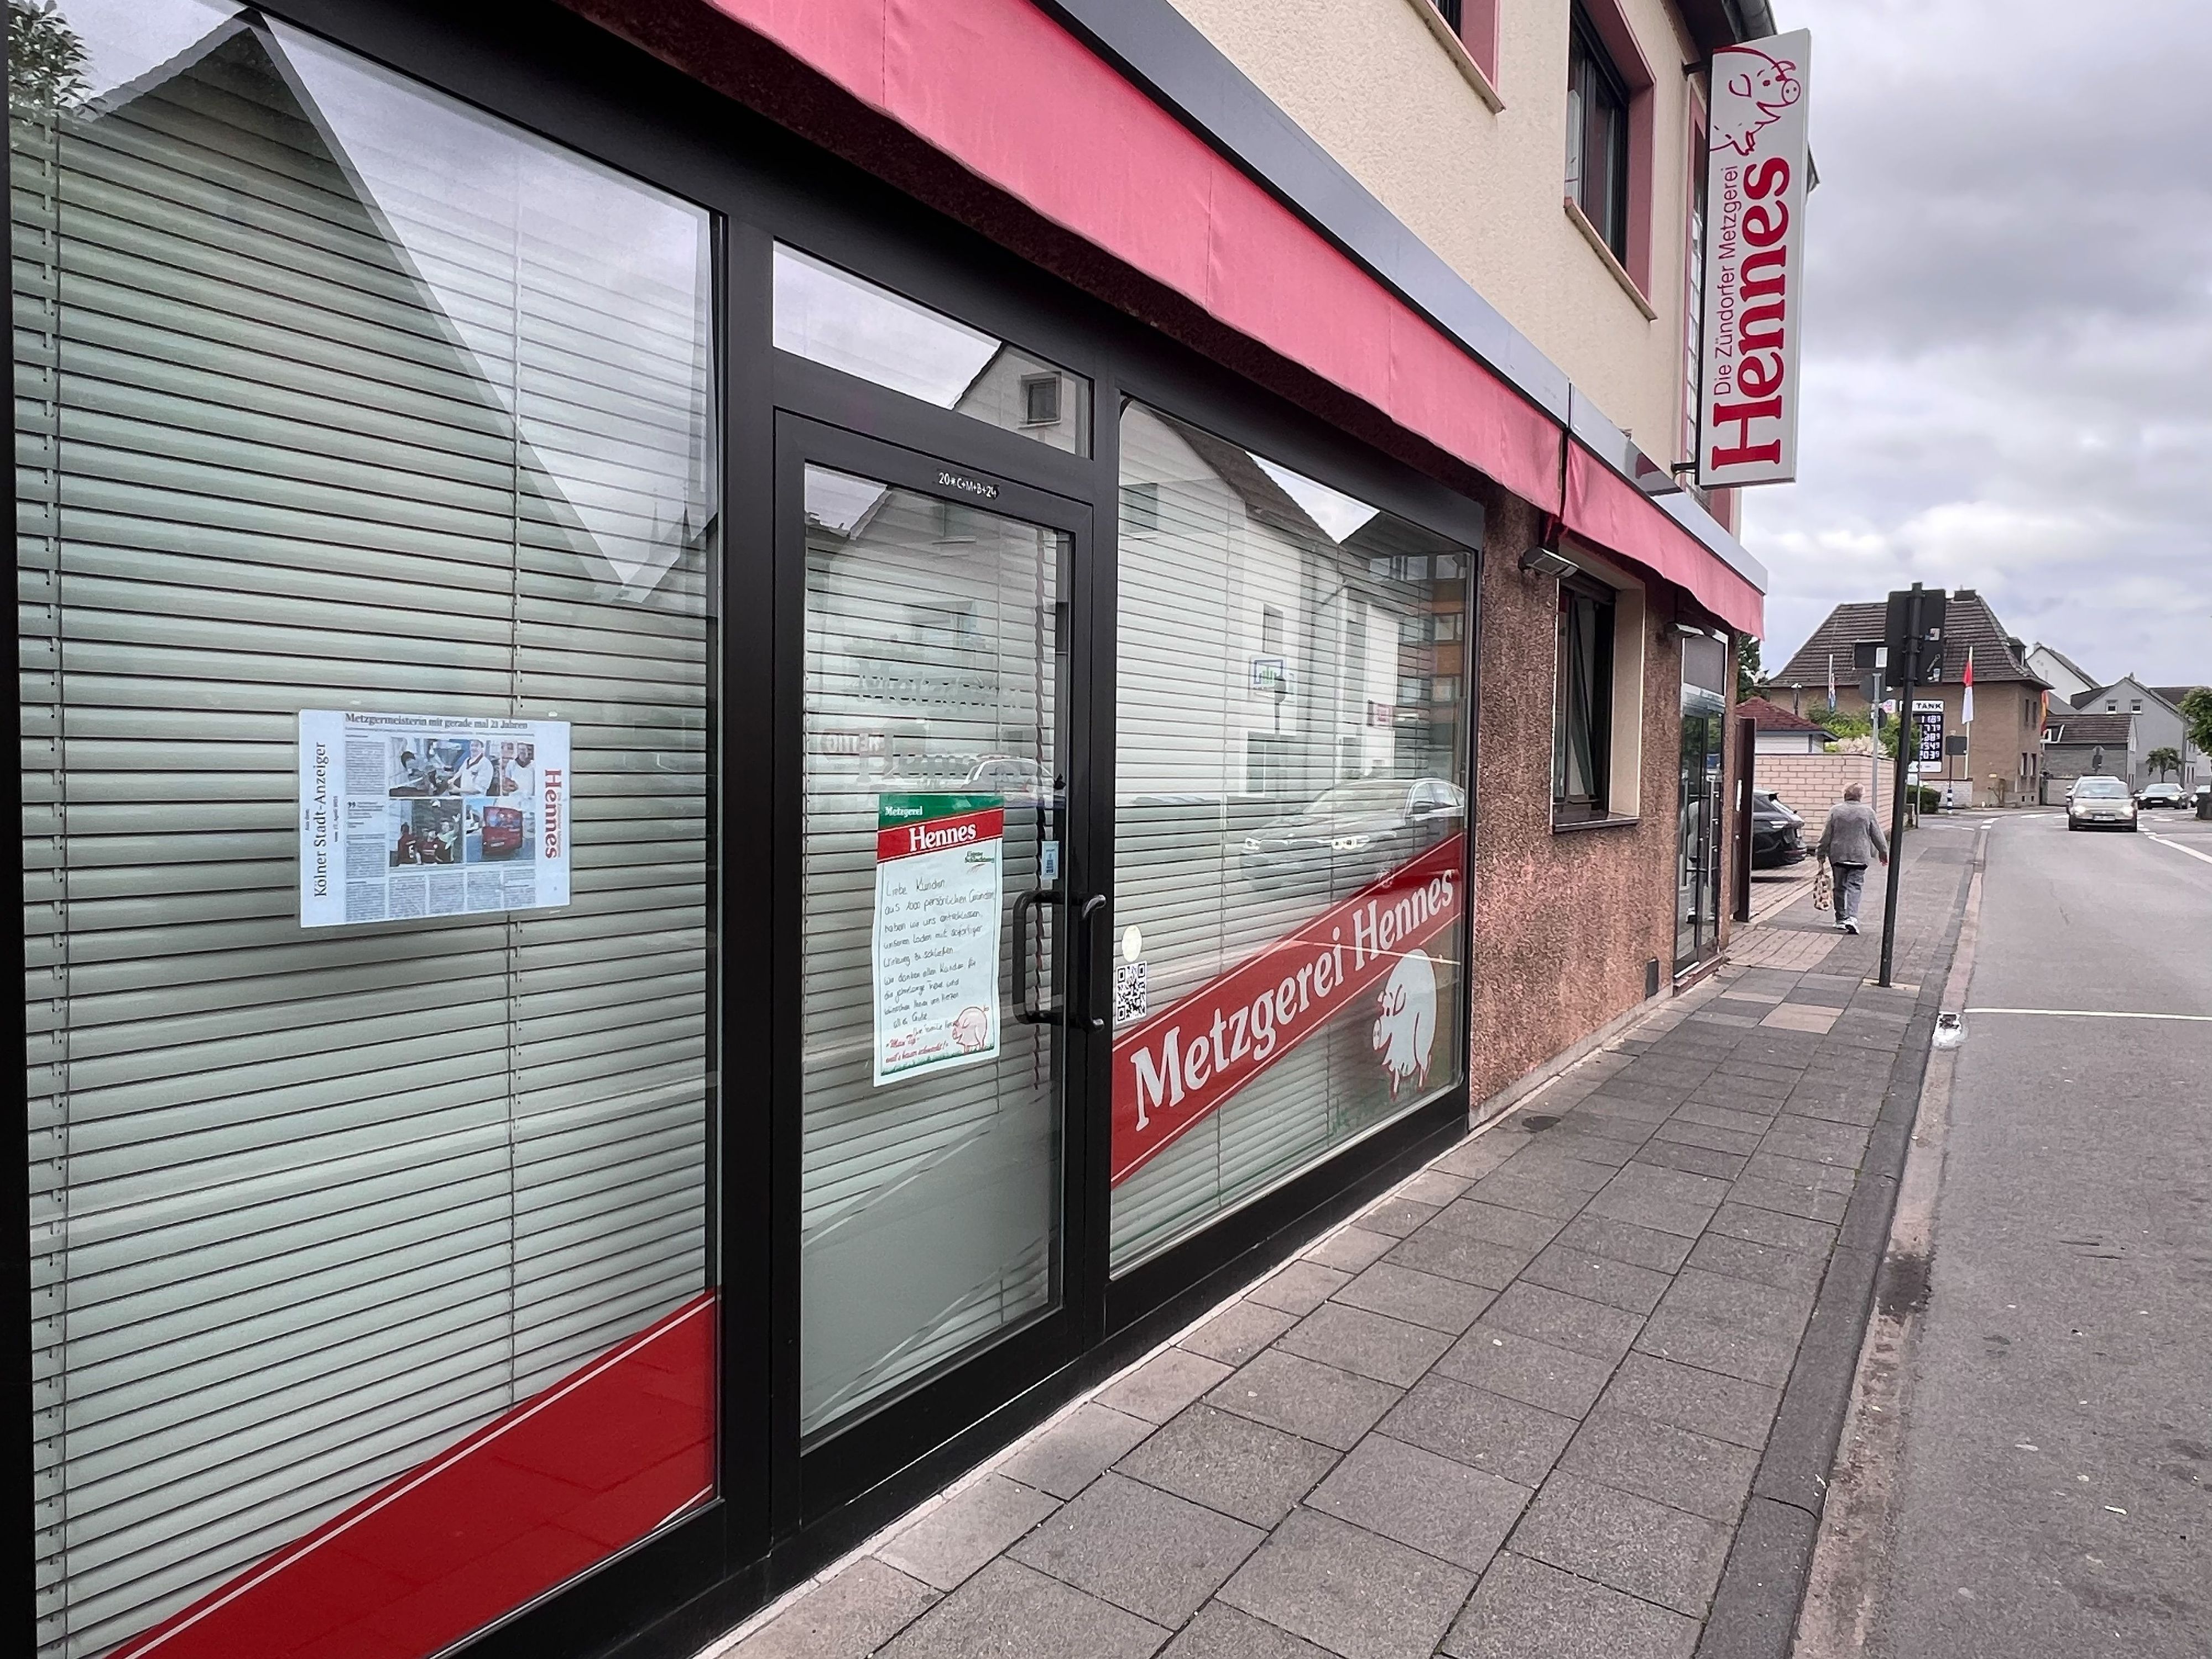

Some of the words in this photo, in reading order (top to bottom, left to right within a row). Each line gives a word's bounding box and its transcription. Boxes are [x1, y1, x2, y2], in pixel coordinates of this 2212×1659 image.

[1718, 165, 1742, 260] Metzgerei
[1712, 157, 1790, 471] Hennes
[1715, 267, 1735, 358] Zündorfer
[1714, 364, 1732, 395] Die
[345, 713, 427, 726] Metzgermeisterin
[445, 718, 472, 729] gerade
[474, 719, 488, 728] mal
[491, 720, 498, 728] 21
[500, 720, 528, 729] Jahren
[313, 742, 329, 847] Stadt-Anzeiger
[545, 769, 562, 858] Hennes
[885, 806, 923, 818] Metzgerei
[909, 823, 977, 852] Hennes
[314, 851, 327, 897] Kölner
[1131, 926, 1343, 1131] Metzgerei
[1353, 869, 1454, 972] Hennes
